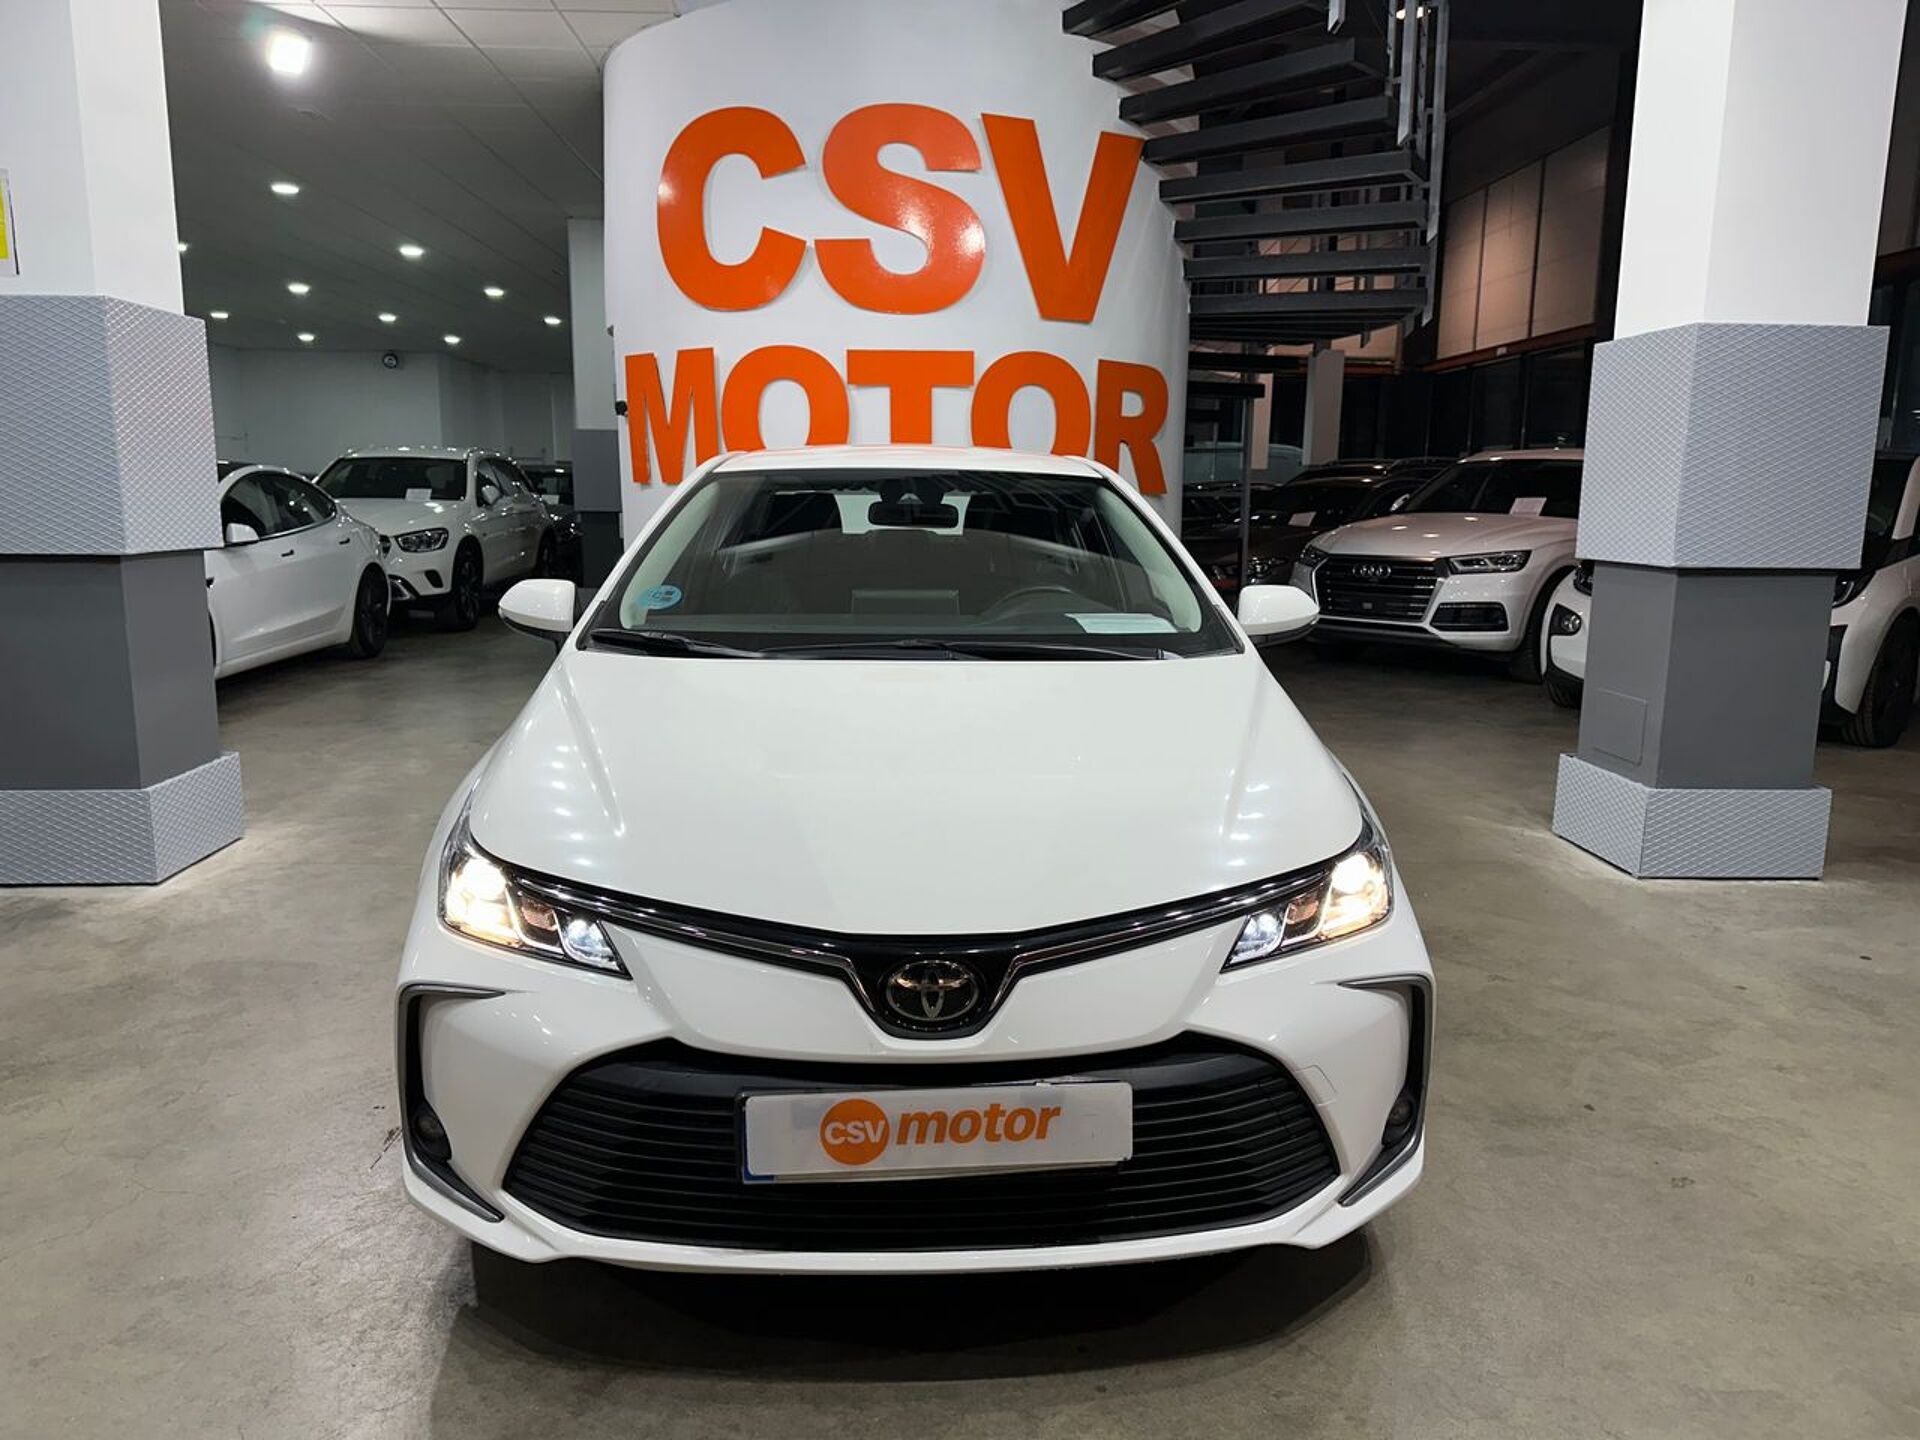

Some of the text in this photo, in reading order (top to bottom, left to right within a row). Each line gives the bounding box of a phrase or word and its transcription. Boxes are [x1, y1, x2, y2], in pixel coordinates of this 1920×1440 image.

[657, 103, 1144, 322] CSV
[625, 345, 1168, 495] MOTOR
[896, 1103, 1060, 1145] motor
